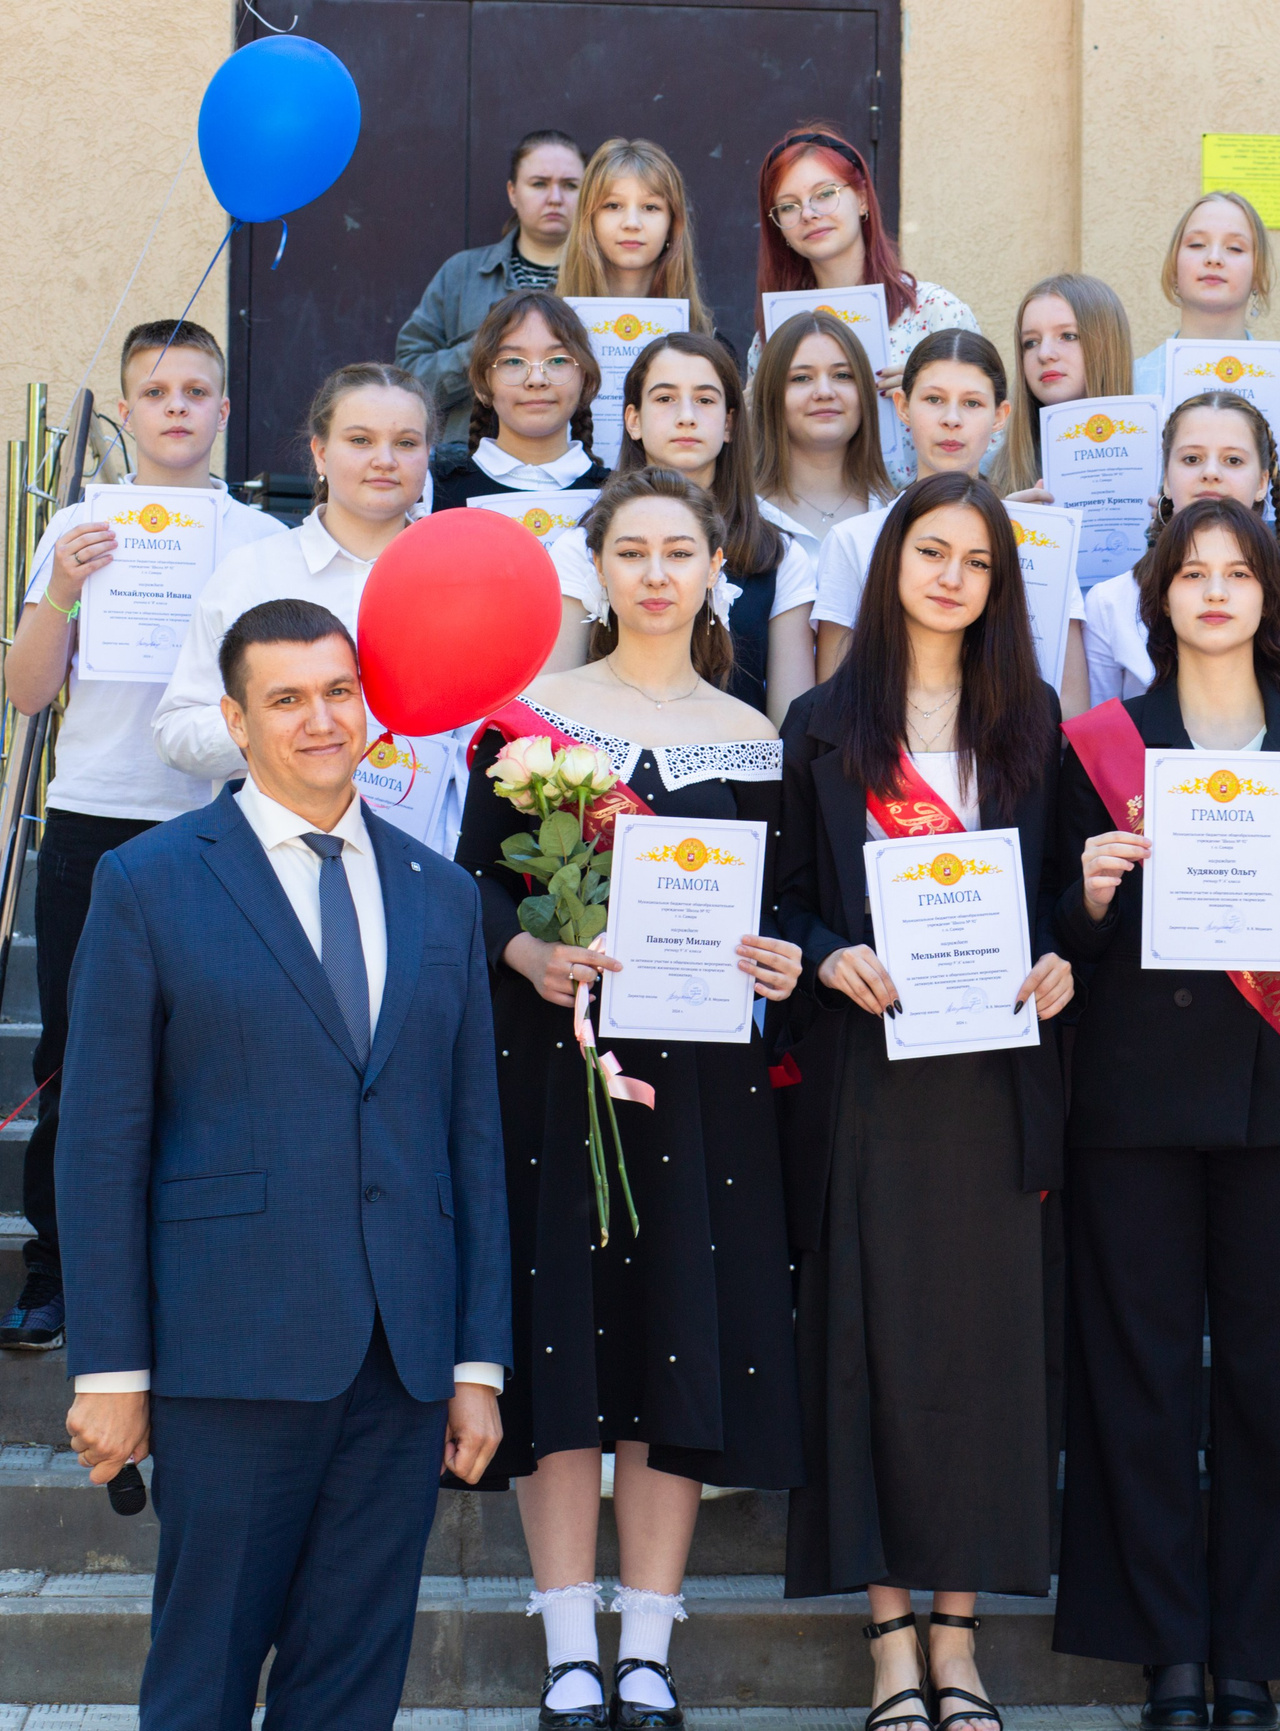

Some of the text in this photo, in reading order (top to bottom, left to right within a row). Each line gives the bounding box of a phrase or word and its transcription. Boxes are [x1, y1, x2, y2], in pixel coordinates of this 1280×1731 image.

[602, 346, 645, 356] ГРАМО
[1074, 447, 1129, 461] ГРАМОТА
[1064, 497, 1144, 509] Дмитриеву Кристину
[124, 538, 182, 551] ГРАМОТА
[110, 589, 192, 600] Михайлусова Ивана
[354, 769, 403, 792] РАМОТА
[1191, 808, 1255, 822] ГРАМОТА
[1187, 867, 1257, 877] Худякову Ольгу
[657, 877, 720, 892] ГРАМОТА
[918, 890, 982, 906] ГРАМОТА
[646, 935, 721, 948] Павлову Милану
[911, 947, 1000, 960] Мельник Викторию
